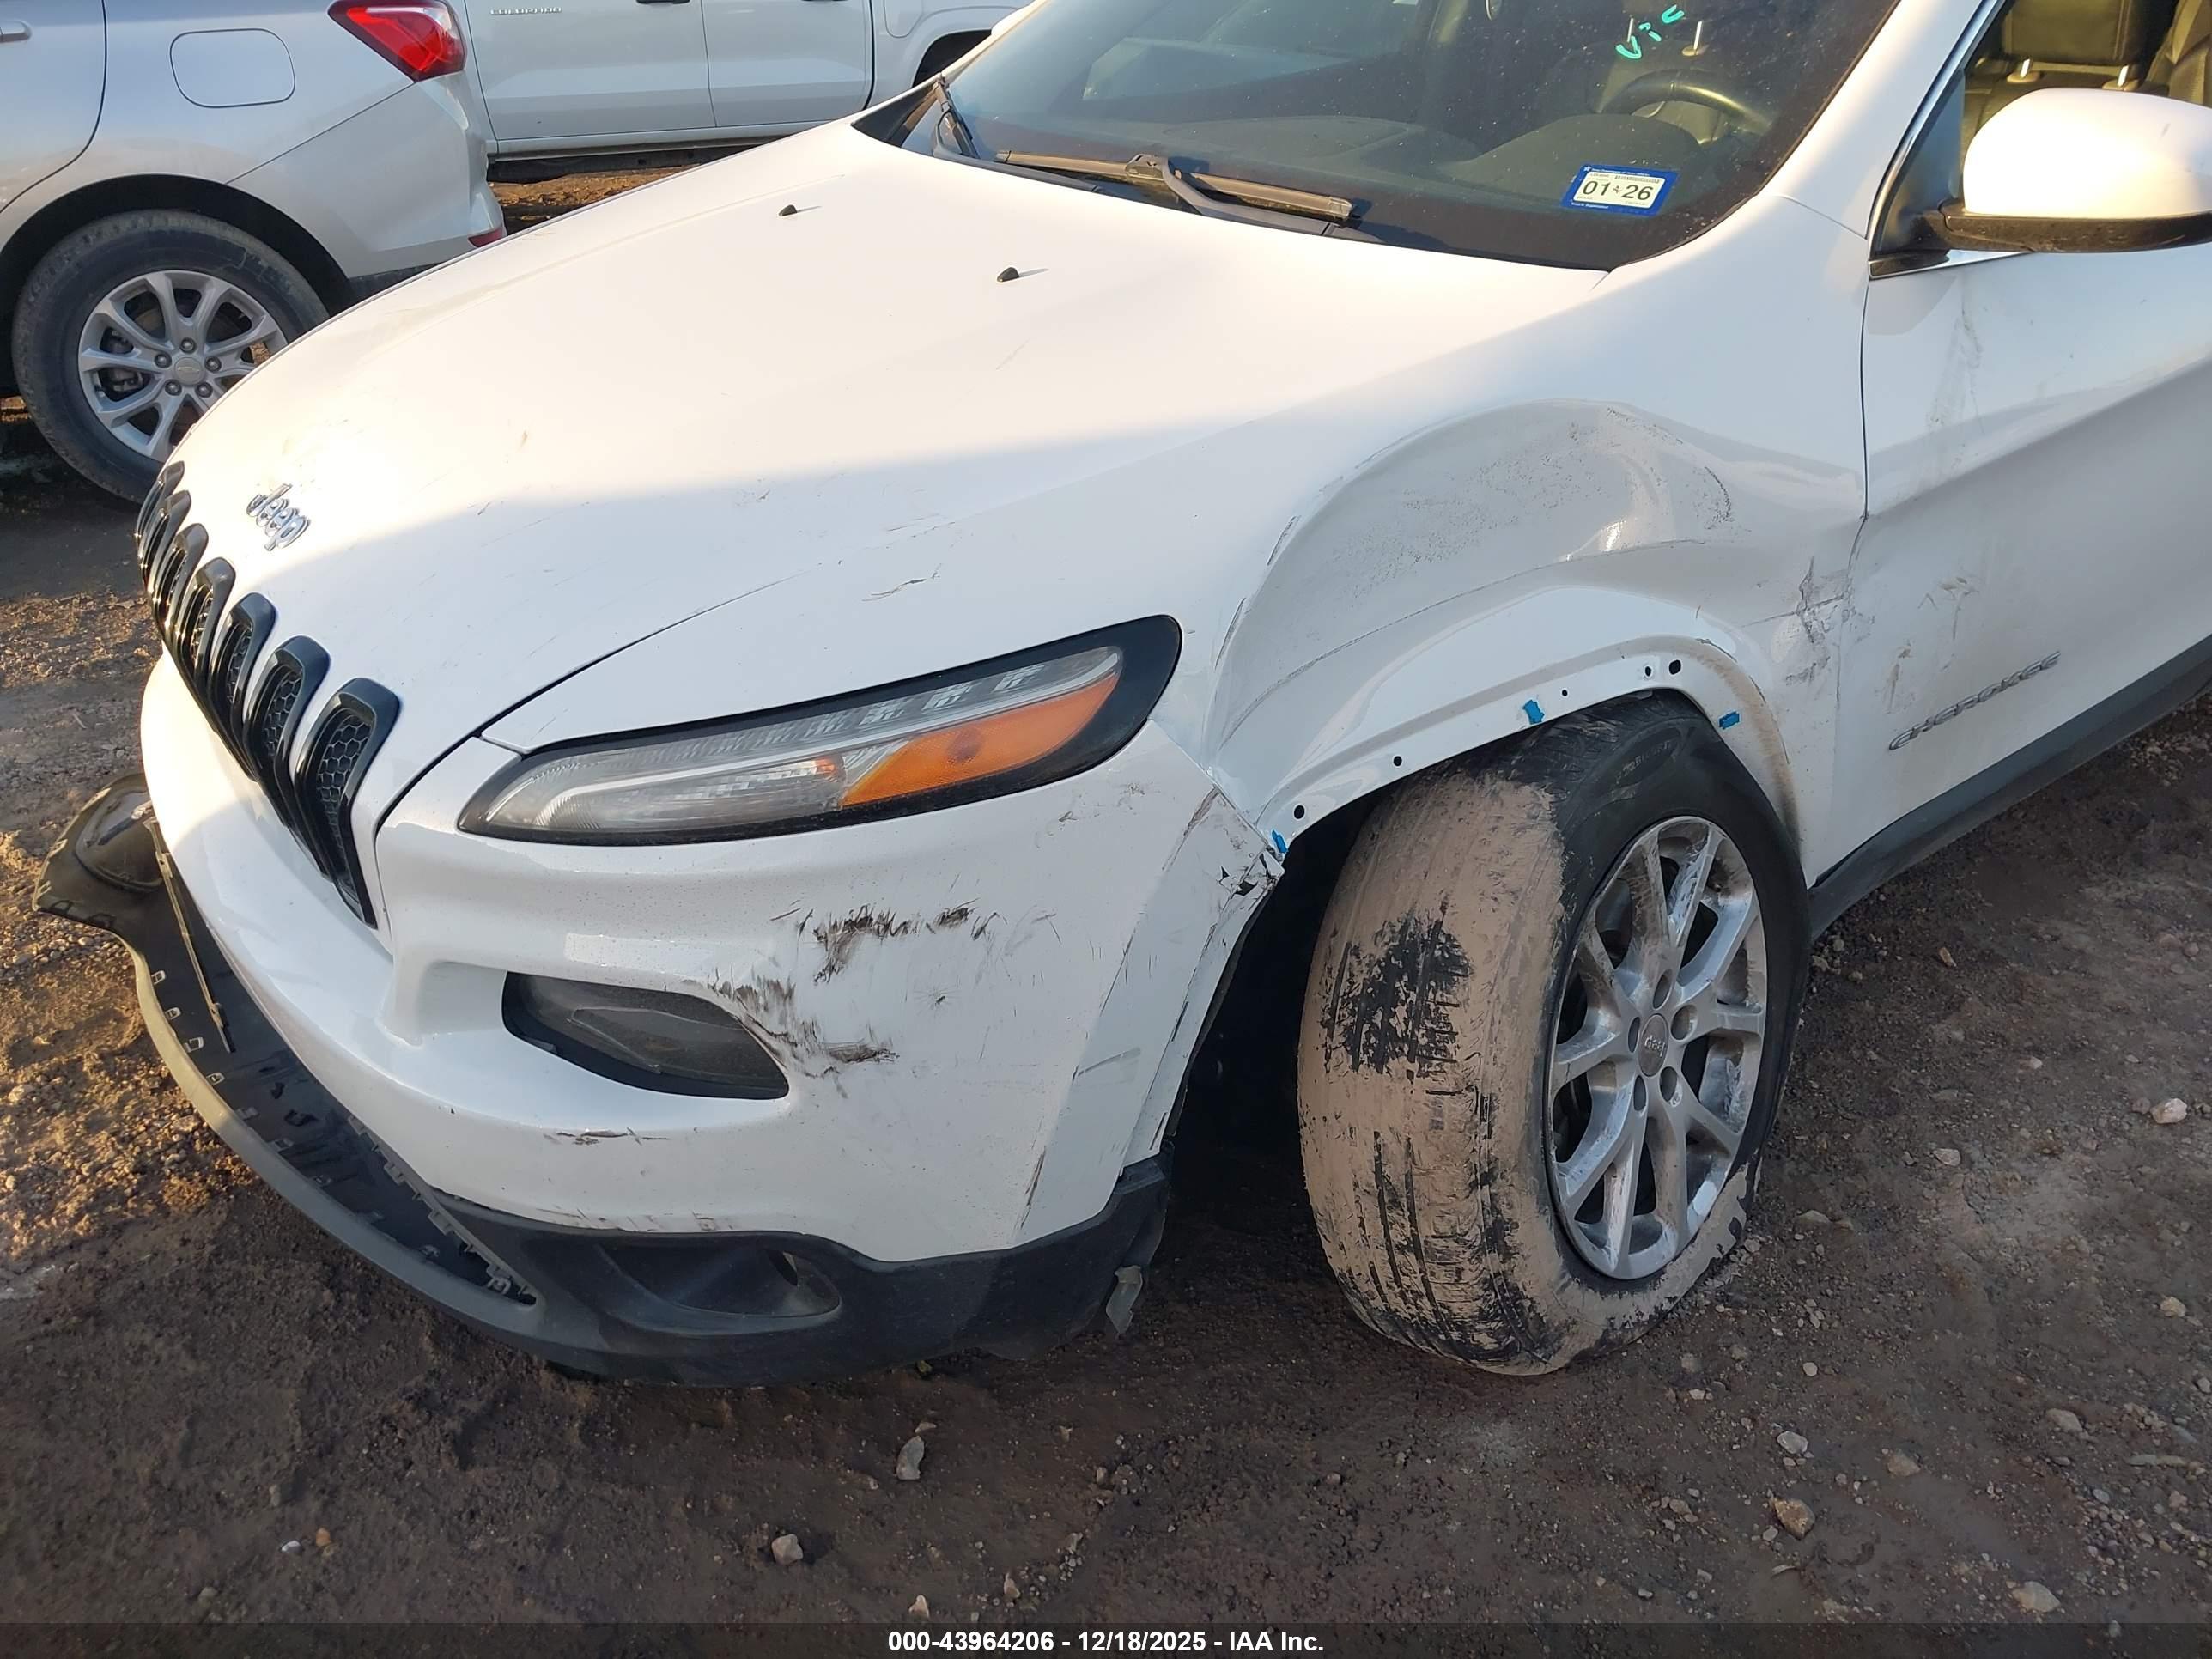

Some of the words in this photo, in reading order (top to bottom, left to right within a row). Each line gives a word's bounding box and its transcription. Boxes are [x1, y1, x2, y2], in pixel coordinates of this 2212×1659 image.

[490, 7, 562, 15] COLORADO
[1583, 180, 1611, 196] 01
[1621, 184, 1654, 201] 26
[246, 483, 311, 551] Jeep
